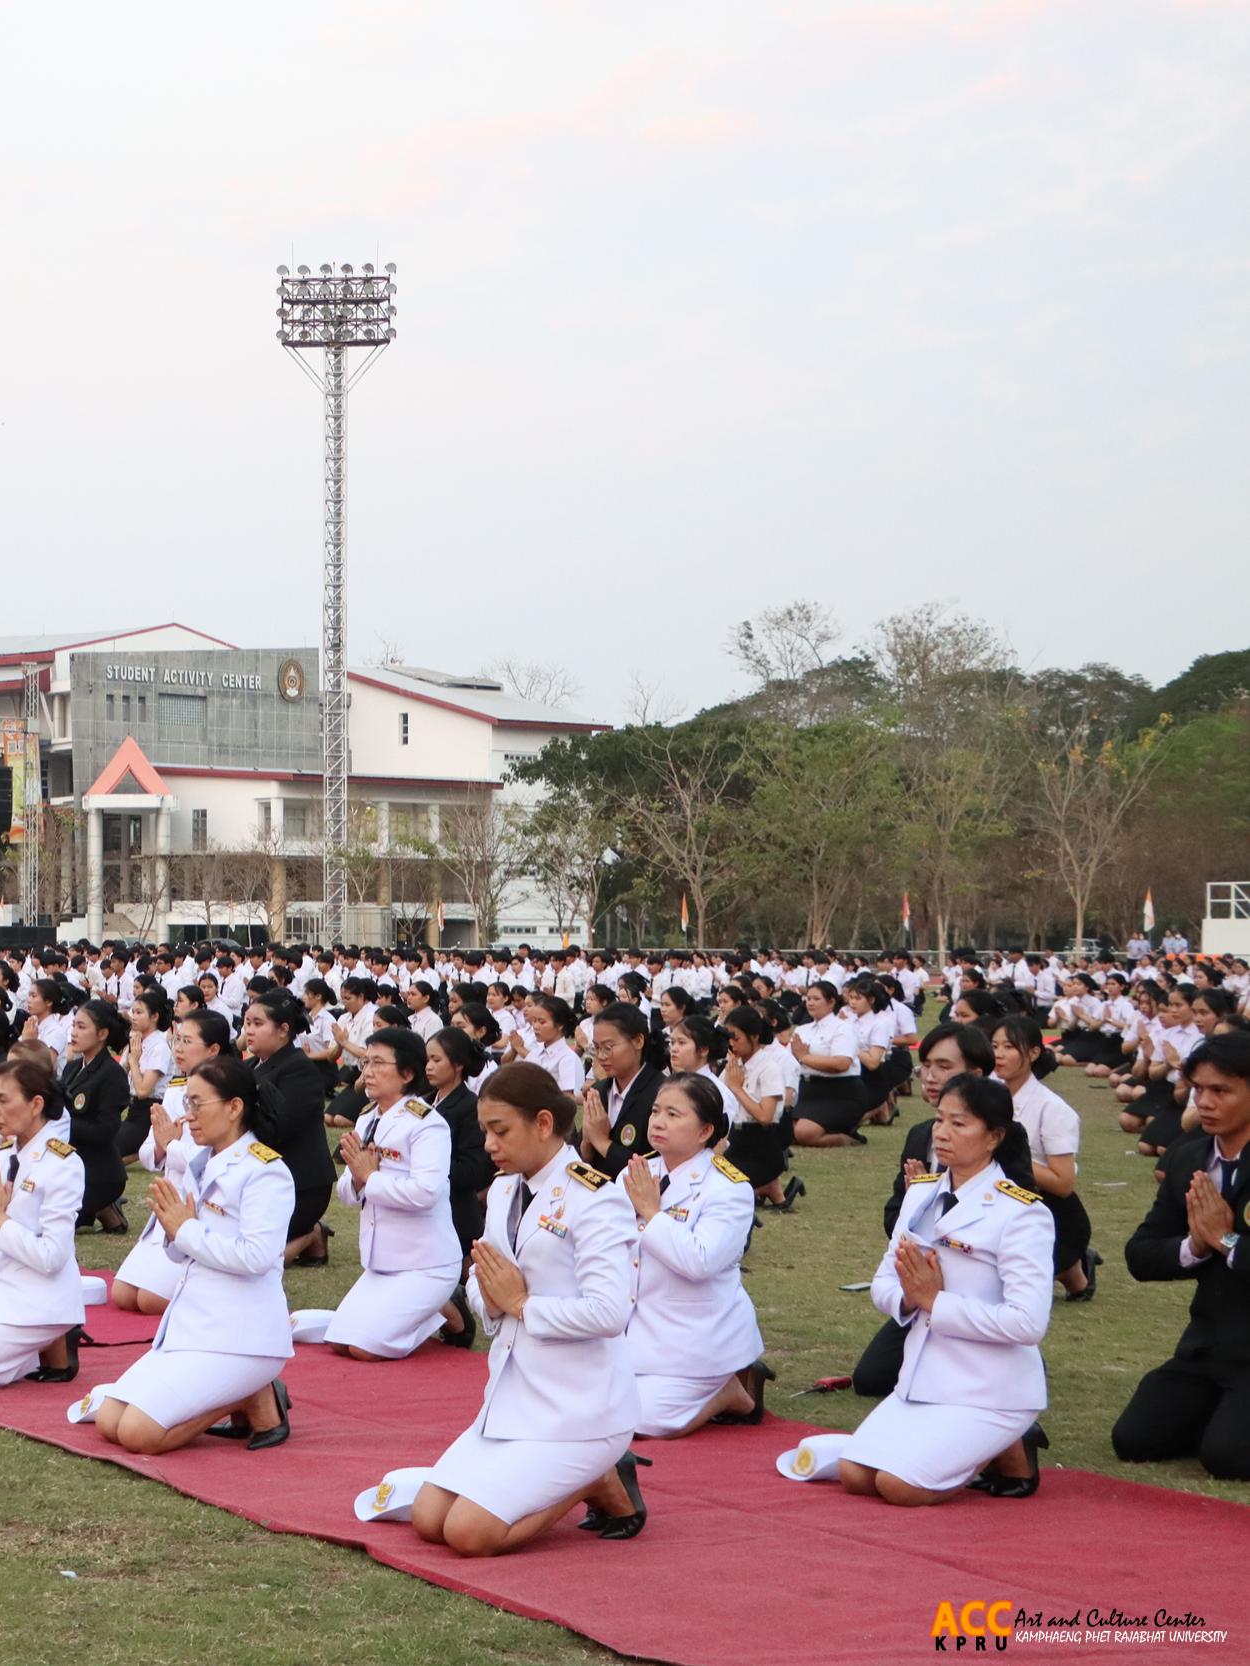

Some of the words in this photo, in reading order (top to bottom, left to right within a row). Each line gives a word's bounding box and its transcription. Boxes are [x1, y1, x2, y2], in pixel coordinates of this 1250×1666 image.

[106, 664, 155, 682] STUDENT
[163, 668, 214, 687] ACTIVITY
[222, 672, 262, 690] CENTER
